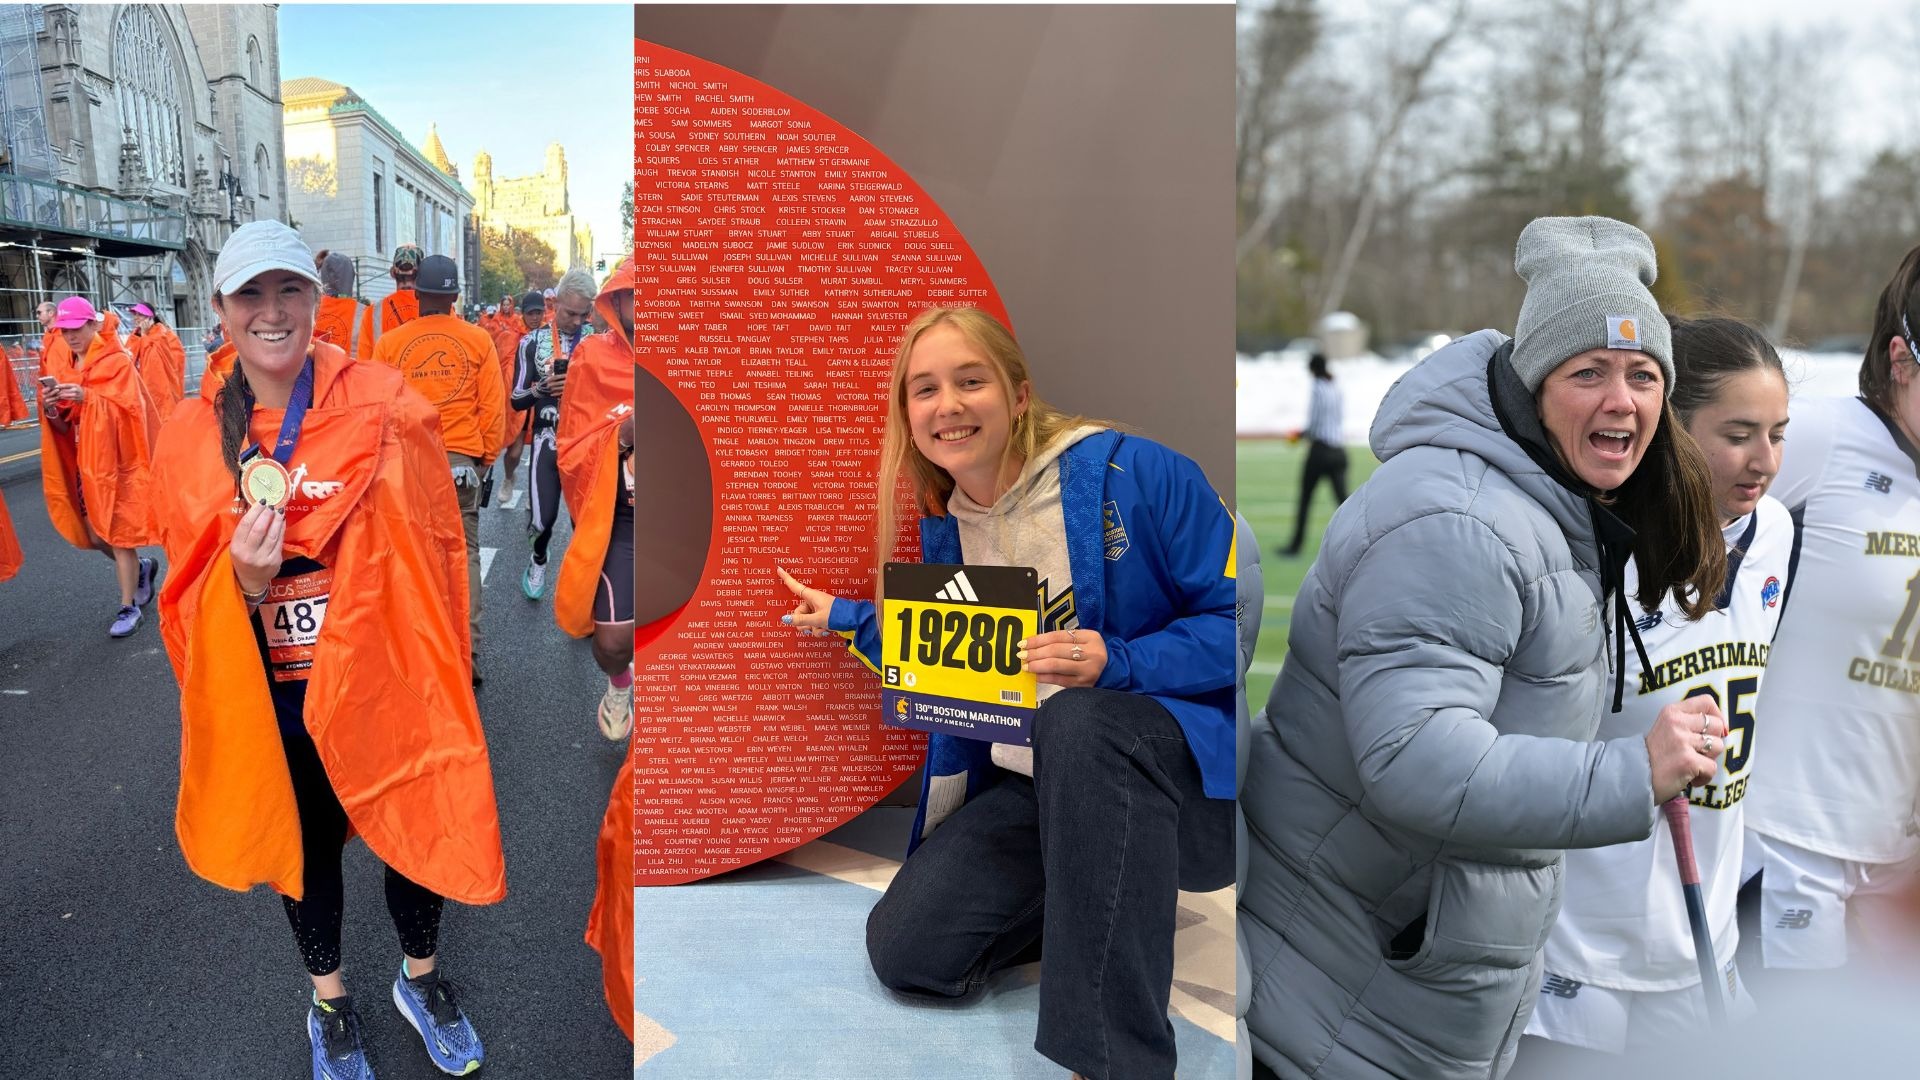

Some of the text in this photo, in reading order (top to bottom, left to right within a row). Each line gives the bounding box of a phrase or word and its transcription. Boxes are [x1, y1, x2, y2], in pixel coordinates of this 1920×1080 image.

[730, 95, 754, 103] SMITH
[647, 156, 680, 165] SQUIERS
[880, 207, 919, 215] STONAKER
[766, 242, 788, 250] JAMIE
[709, 265, 744, 273] JENNIFER
[657, 288, 696, 297] JONATHAN
[897, 608, 1024, 676] 19280
[1638, 642, 1770, 695] MERRIMAC
[887, 668, 898, 684] 5
[933, 706, 968, 719] BOSTON
[970, 712, 1021, 728] MARATHON
[944, 719, 974, 728] AMERICA
[1682, 676, 1758, 775] 5
